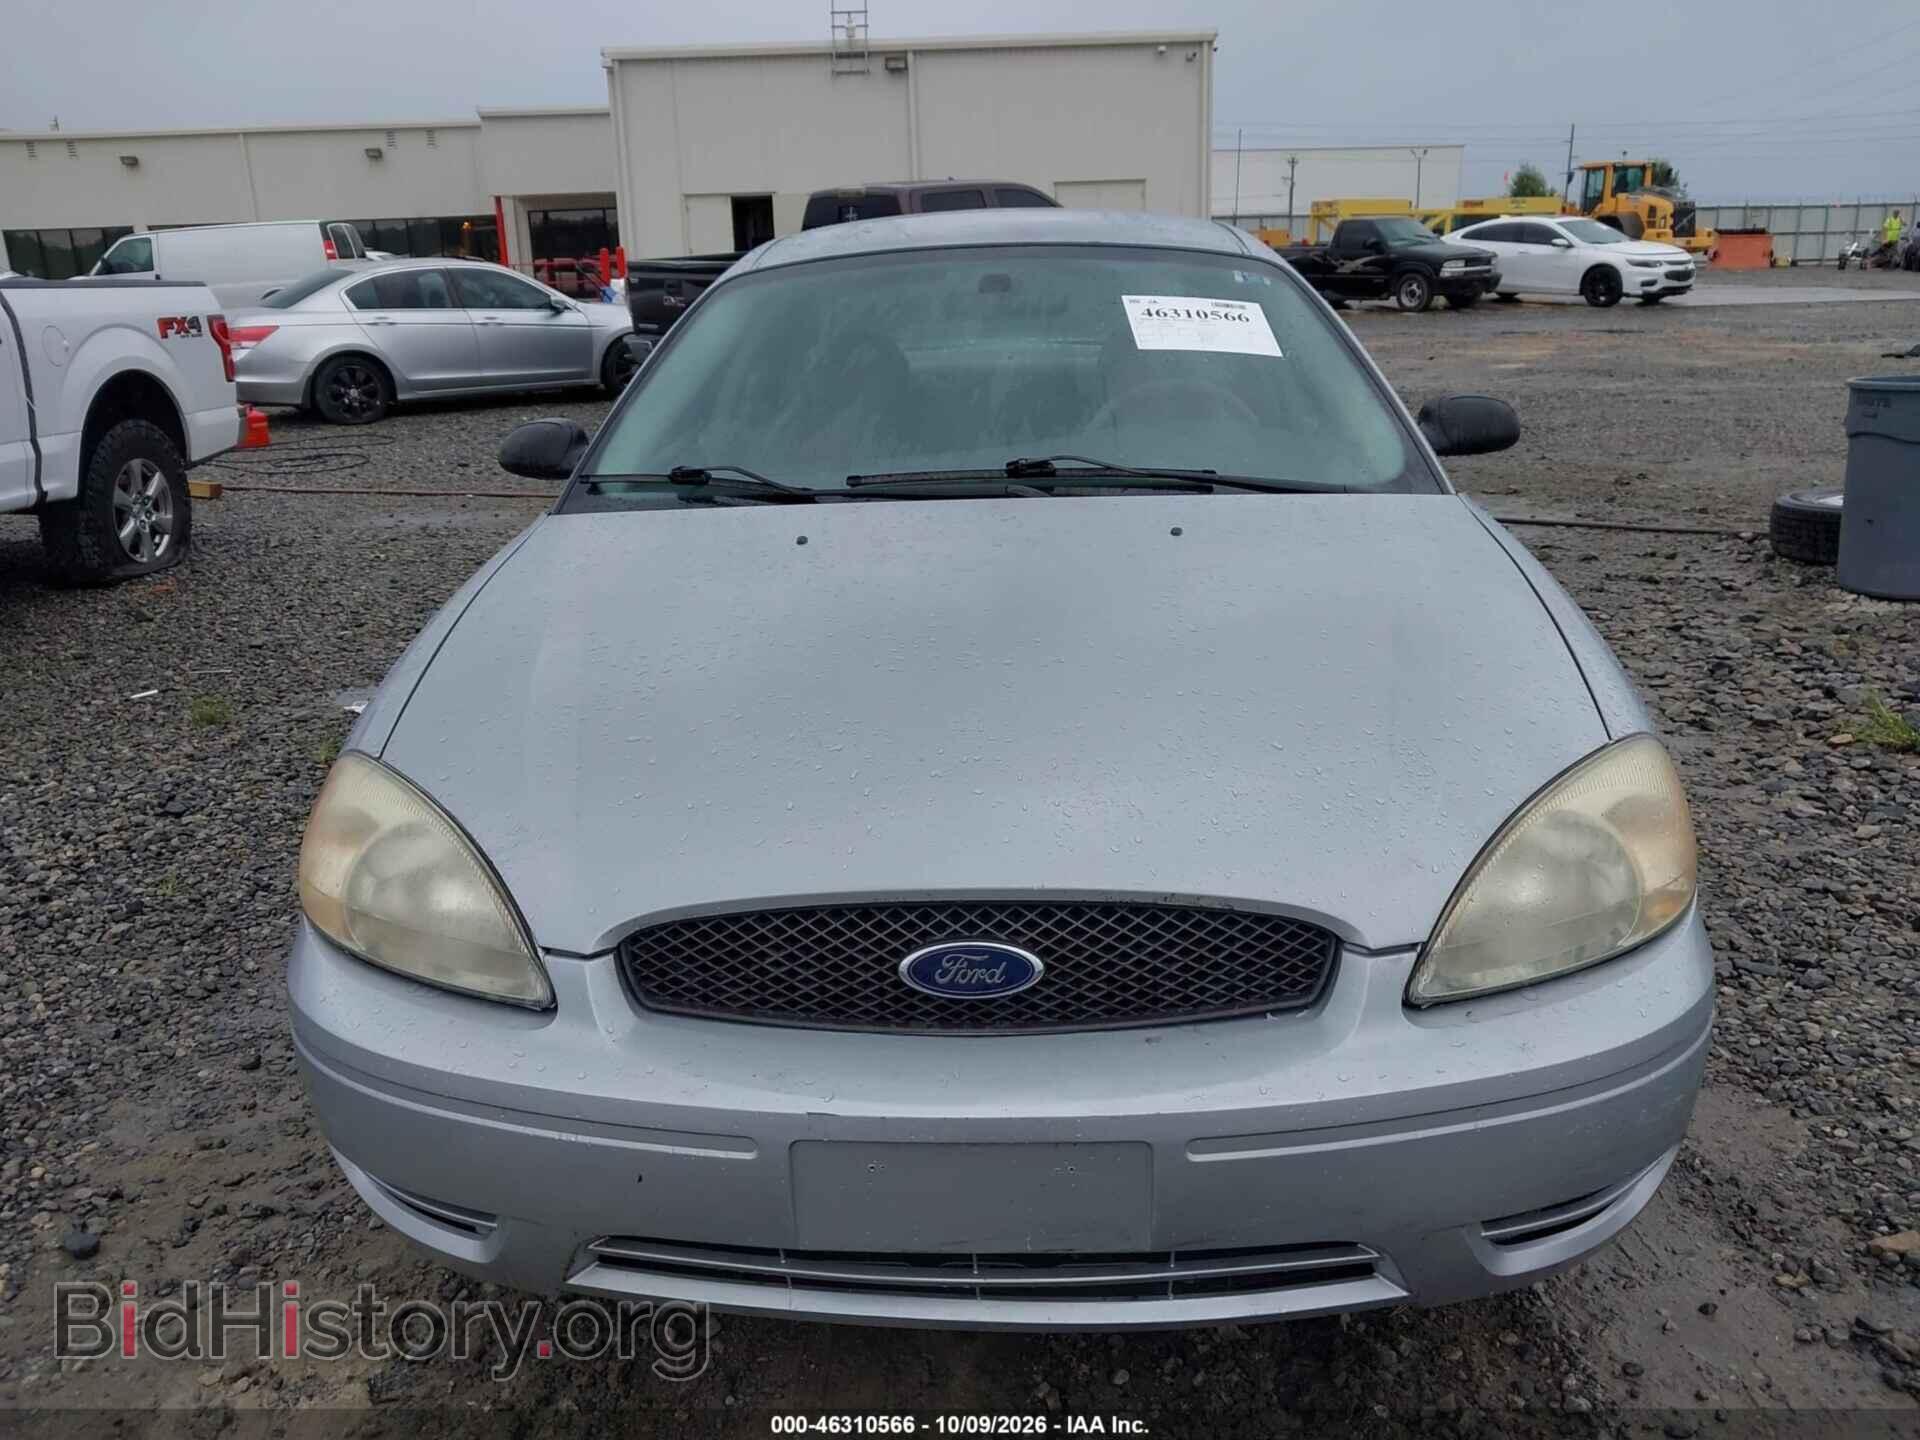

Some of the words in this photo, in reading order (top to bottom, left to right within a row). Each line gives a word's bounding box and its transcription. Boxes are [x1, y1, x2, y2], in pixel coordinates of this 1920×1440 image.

[1141, 307, 1251, 323] 46310566
[157, 316, 202, 339] FX4
[934, 953, 1007, 984] Ford
